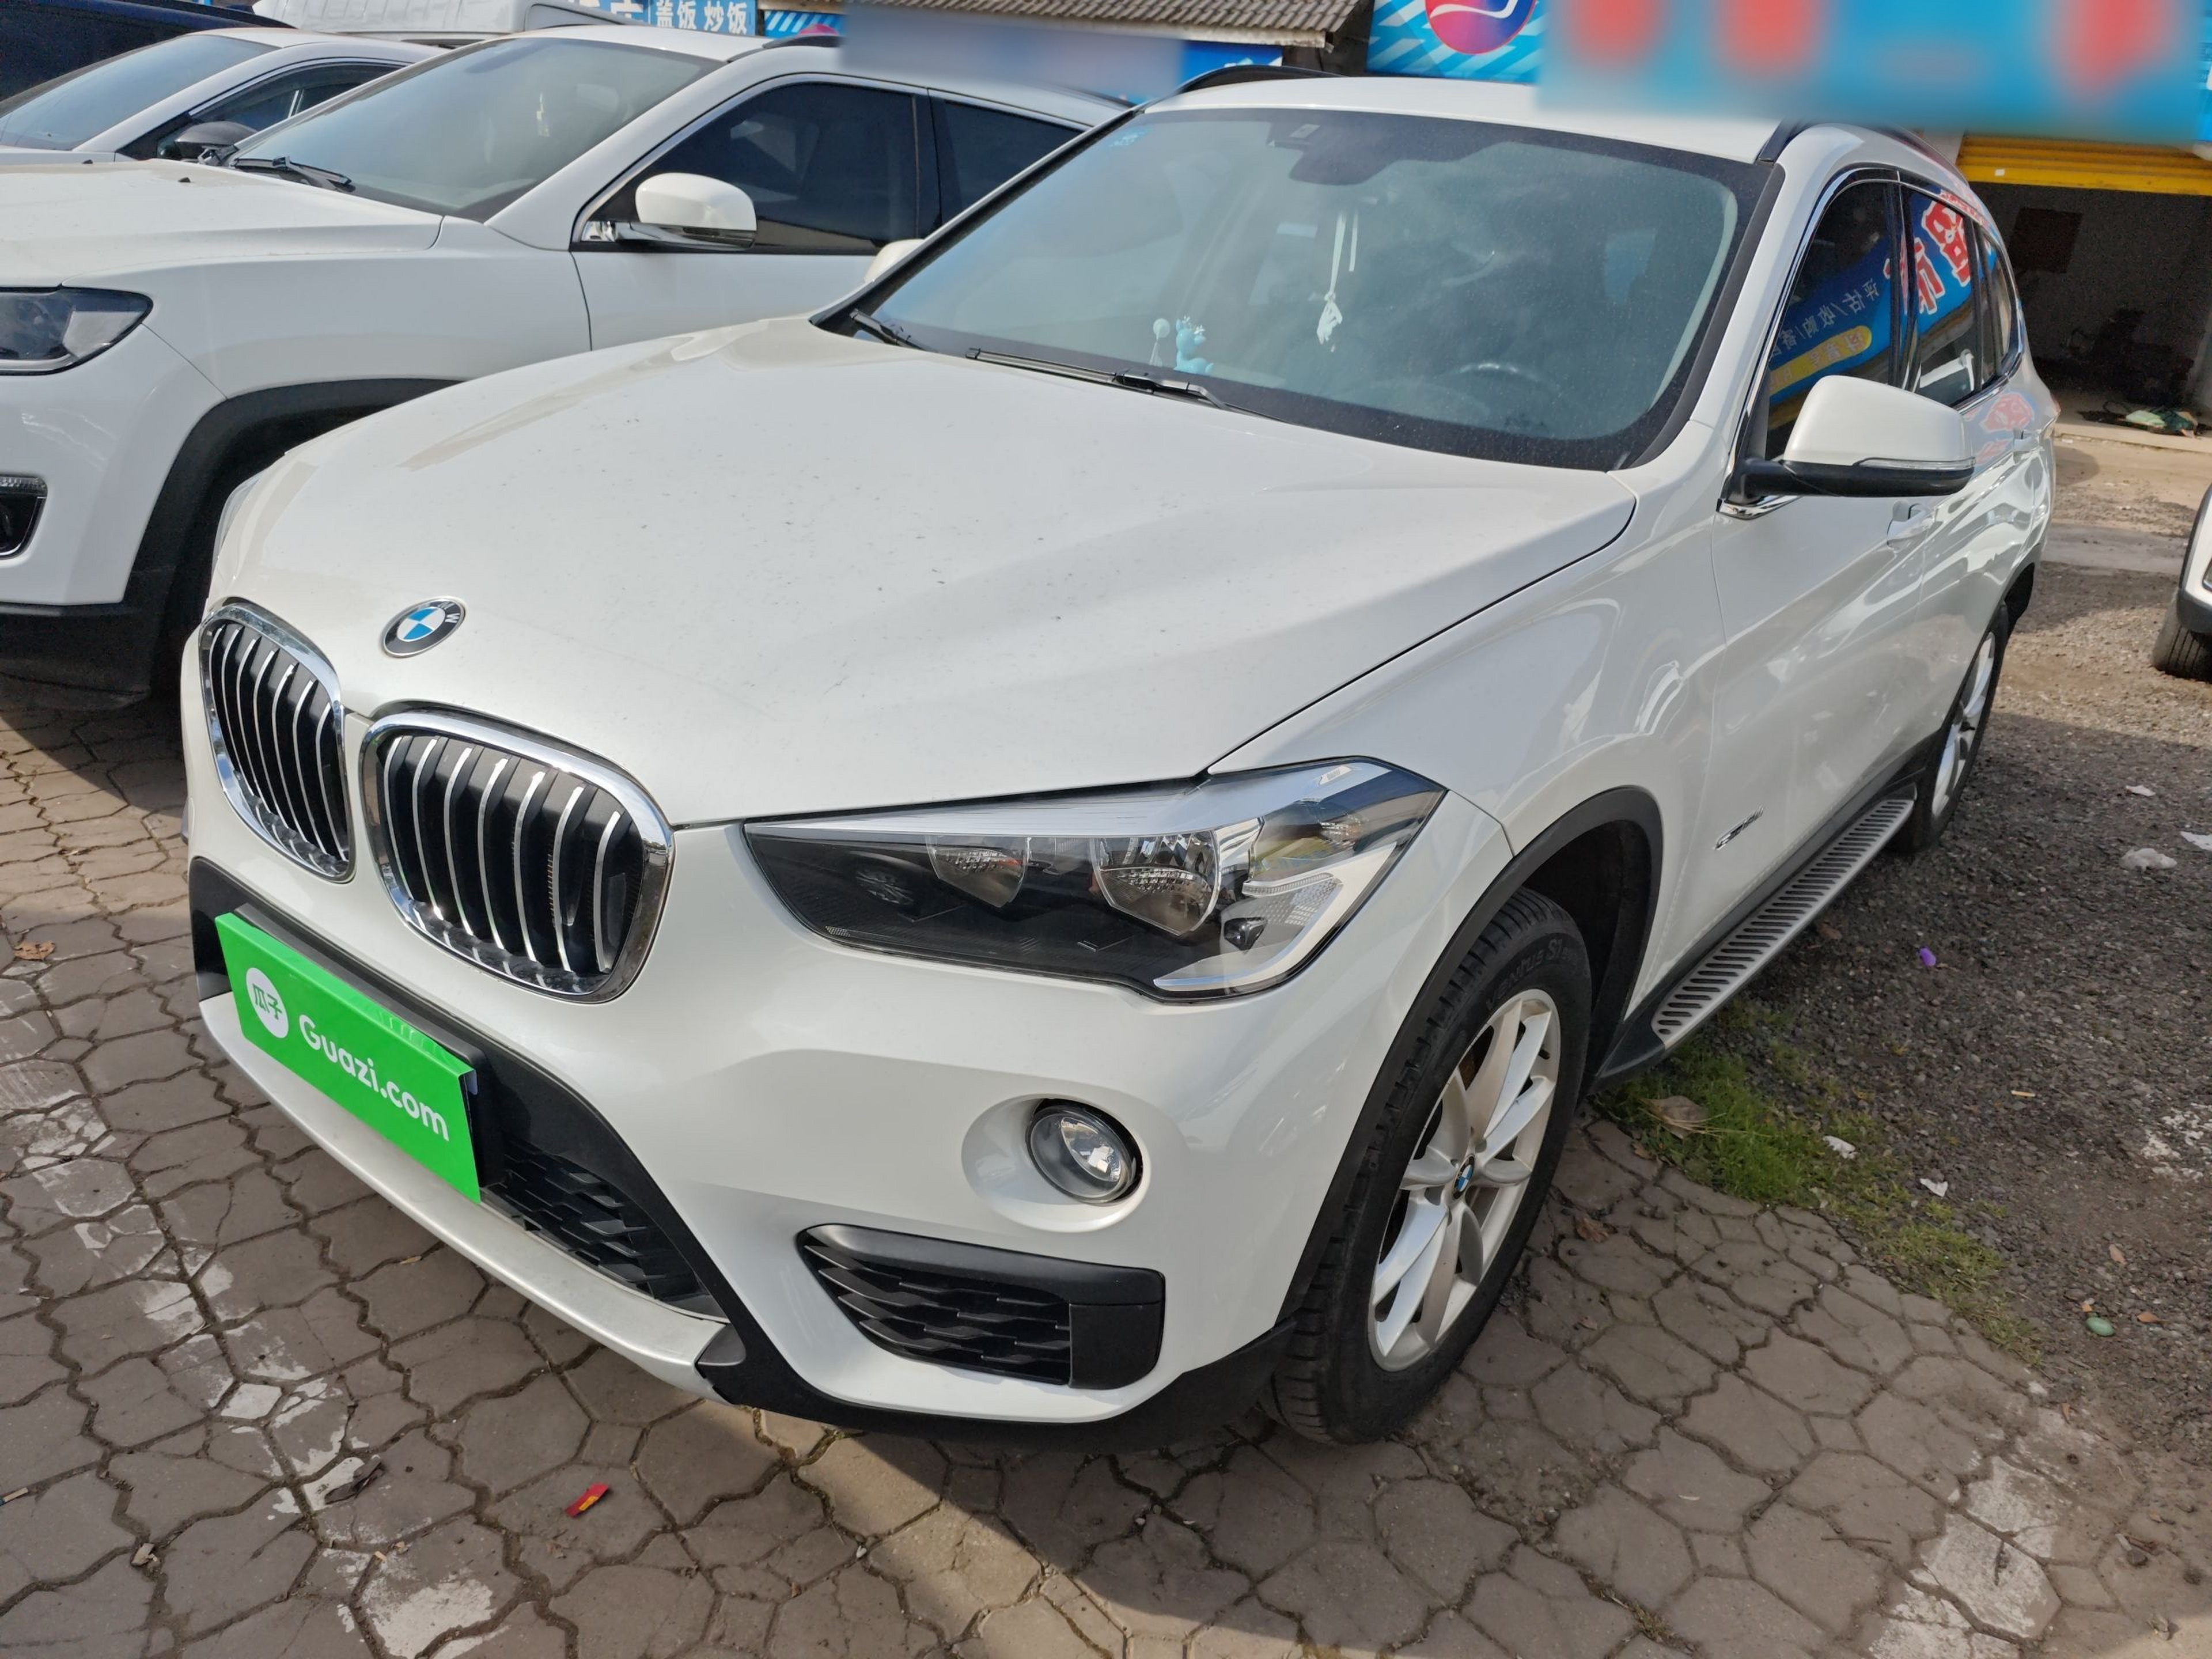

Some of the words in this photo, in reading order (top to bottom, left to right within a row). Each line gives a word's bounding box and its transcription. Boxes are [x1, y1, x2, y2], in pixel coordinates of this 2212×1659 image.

[703, 2, 748, 35] 炒饭
[252, 983, 283, 1020] 瓜子
[299, 1014, 449, 1141] Guazi.com
